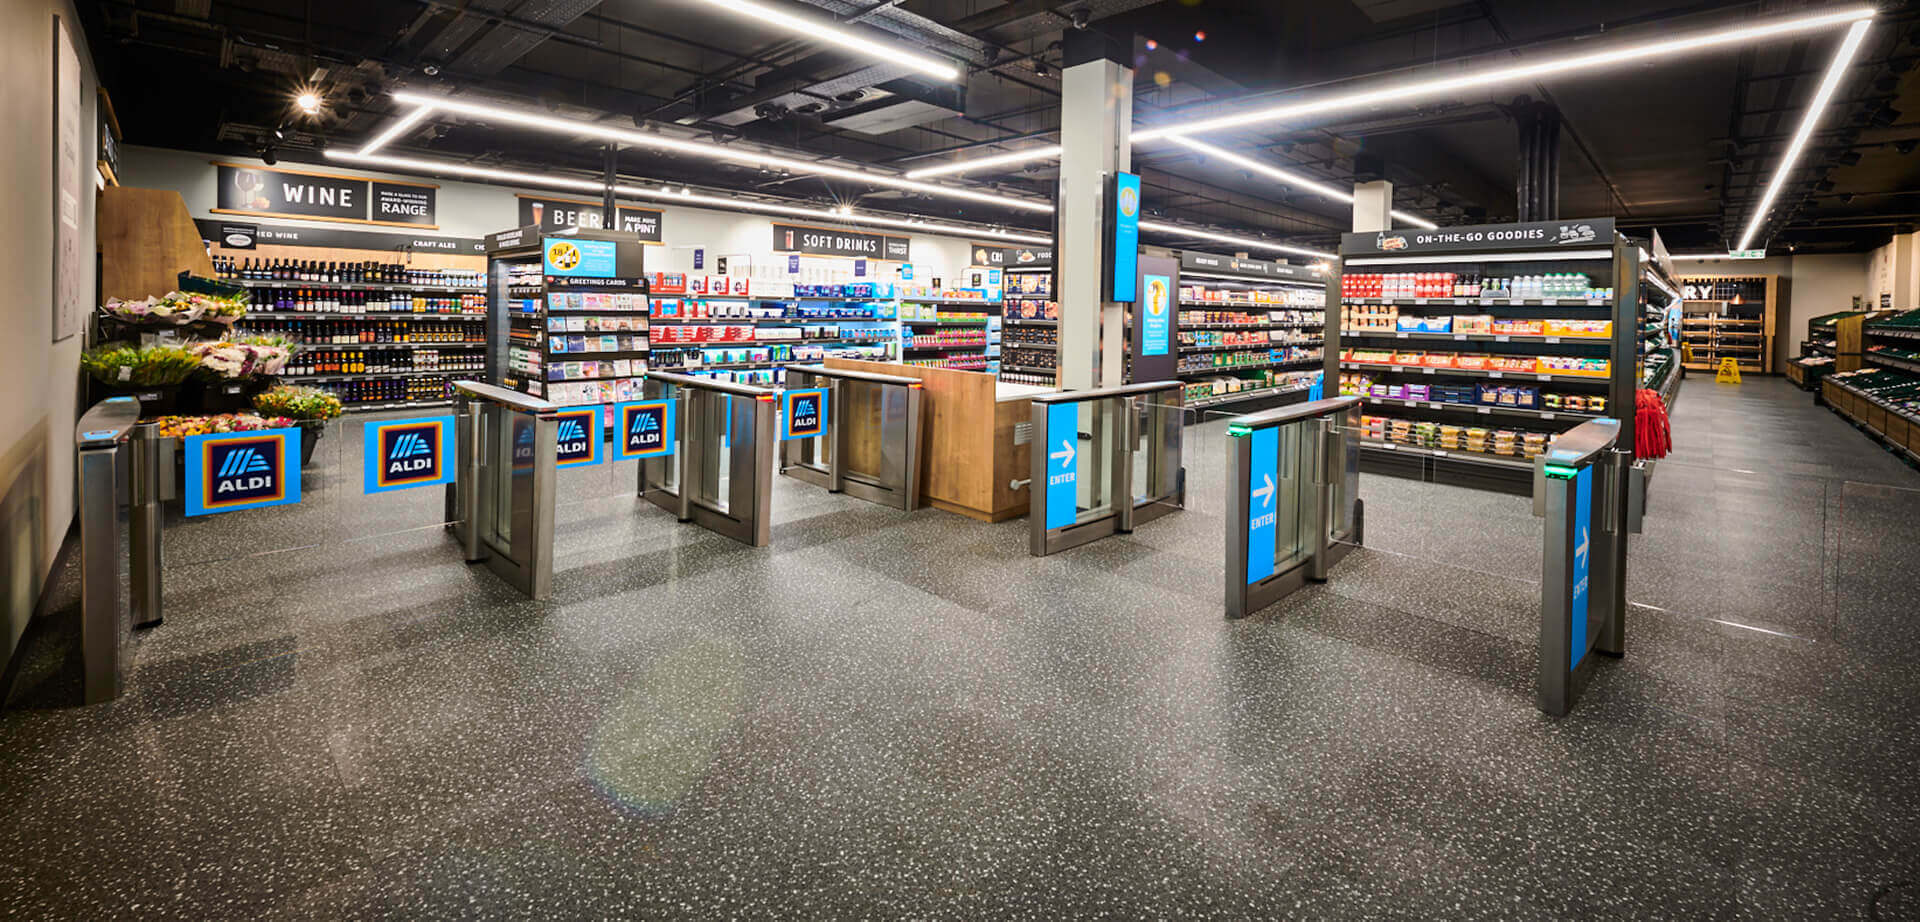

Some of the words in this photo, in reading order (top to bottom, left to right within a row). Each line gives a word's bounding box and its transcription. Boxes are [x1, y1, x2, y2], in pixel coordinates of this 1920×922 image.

[282, 183, 353, 207] WINE
[381, 202, 428, 216] RANGE
[553, 210, 611, 229] BEER
[624, 223, 633, 232] A
[634, 224, 657, 234] PINT
[275, 232, 299, 240] WINE
[803, 234, 833, 249] SOFT
[836, 237, 877, 252] DRINKS
[1416, 232, 1483, 244] ON-THE-GO
[1487, 229, 1545, 241] GOODIES
[413, 240, 436, 248] CRAFT
[438, 241, 457, 249] ALES
[569, 278, 605, 286] GREETINGS
[1683, 285, 1712, 299] RY
[794, 417, 816, 427] ALDI
[630, 433, 660, 445] ALDI
[557, 442, 586, 454] ALDI
[389, 458, 432, 473] ALDI
[217, 475, 272, 493] ALDI
[1050, 472, 1076, 486] ENTER
[1251, 511, 1275, 530] ENTER
